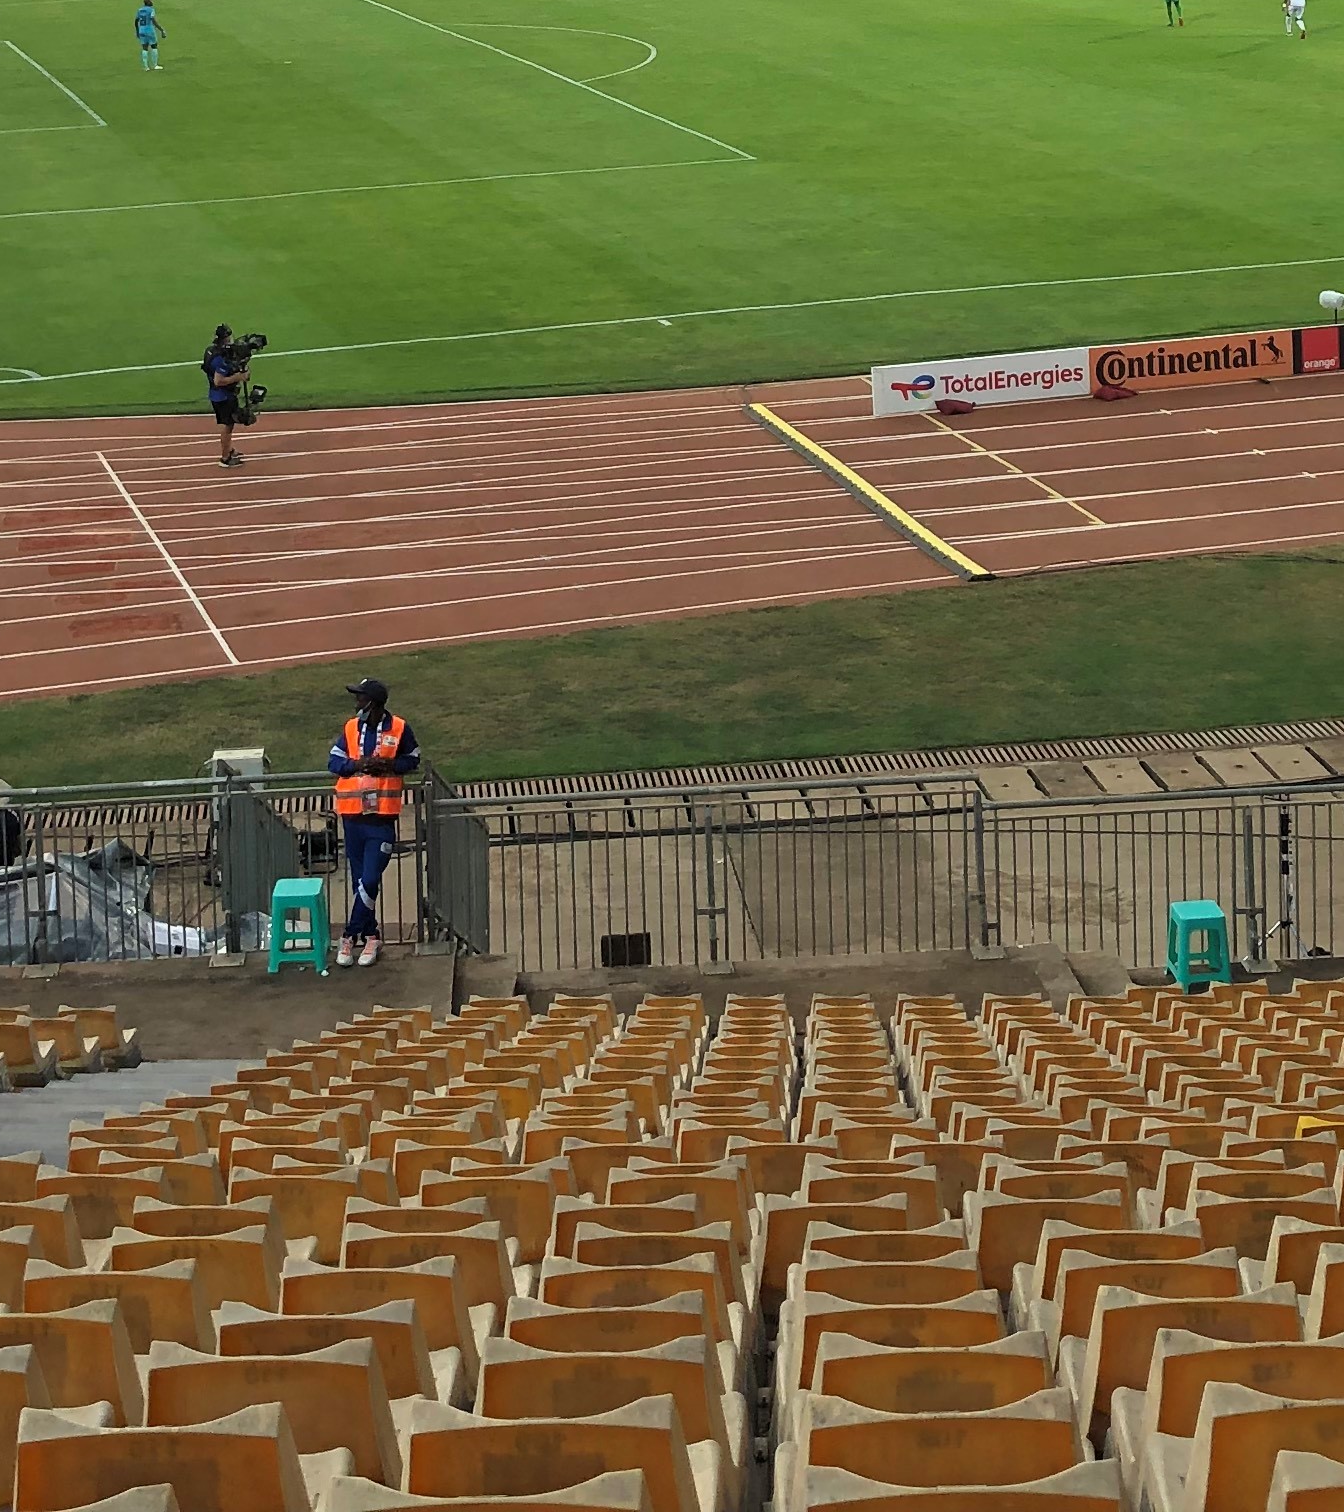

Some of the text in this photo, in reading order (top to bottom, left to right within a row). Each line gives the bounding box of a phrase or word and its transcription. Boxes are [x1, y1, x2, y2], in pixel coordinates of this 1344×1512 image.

[1095, 339, 1259, 387] Continental
[1304, 357, 1336, 370] orange
[940, 364, 1084, 395] TotalEnergies
